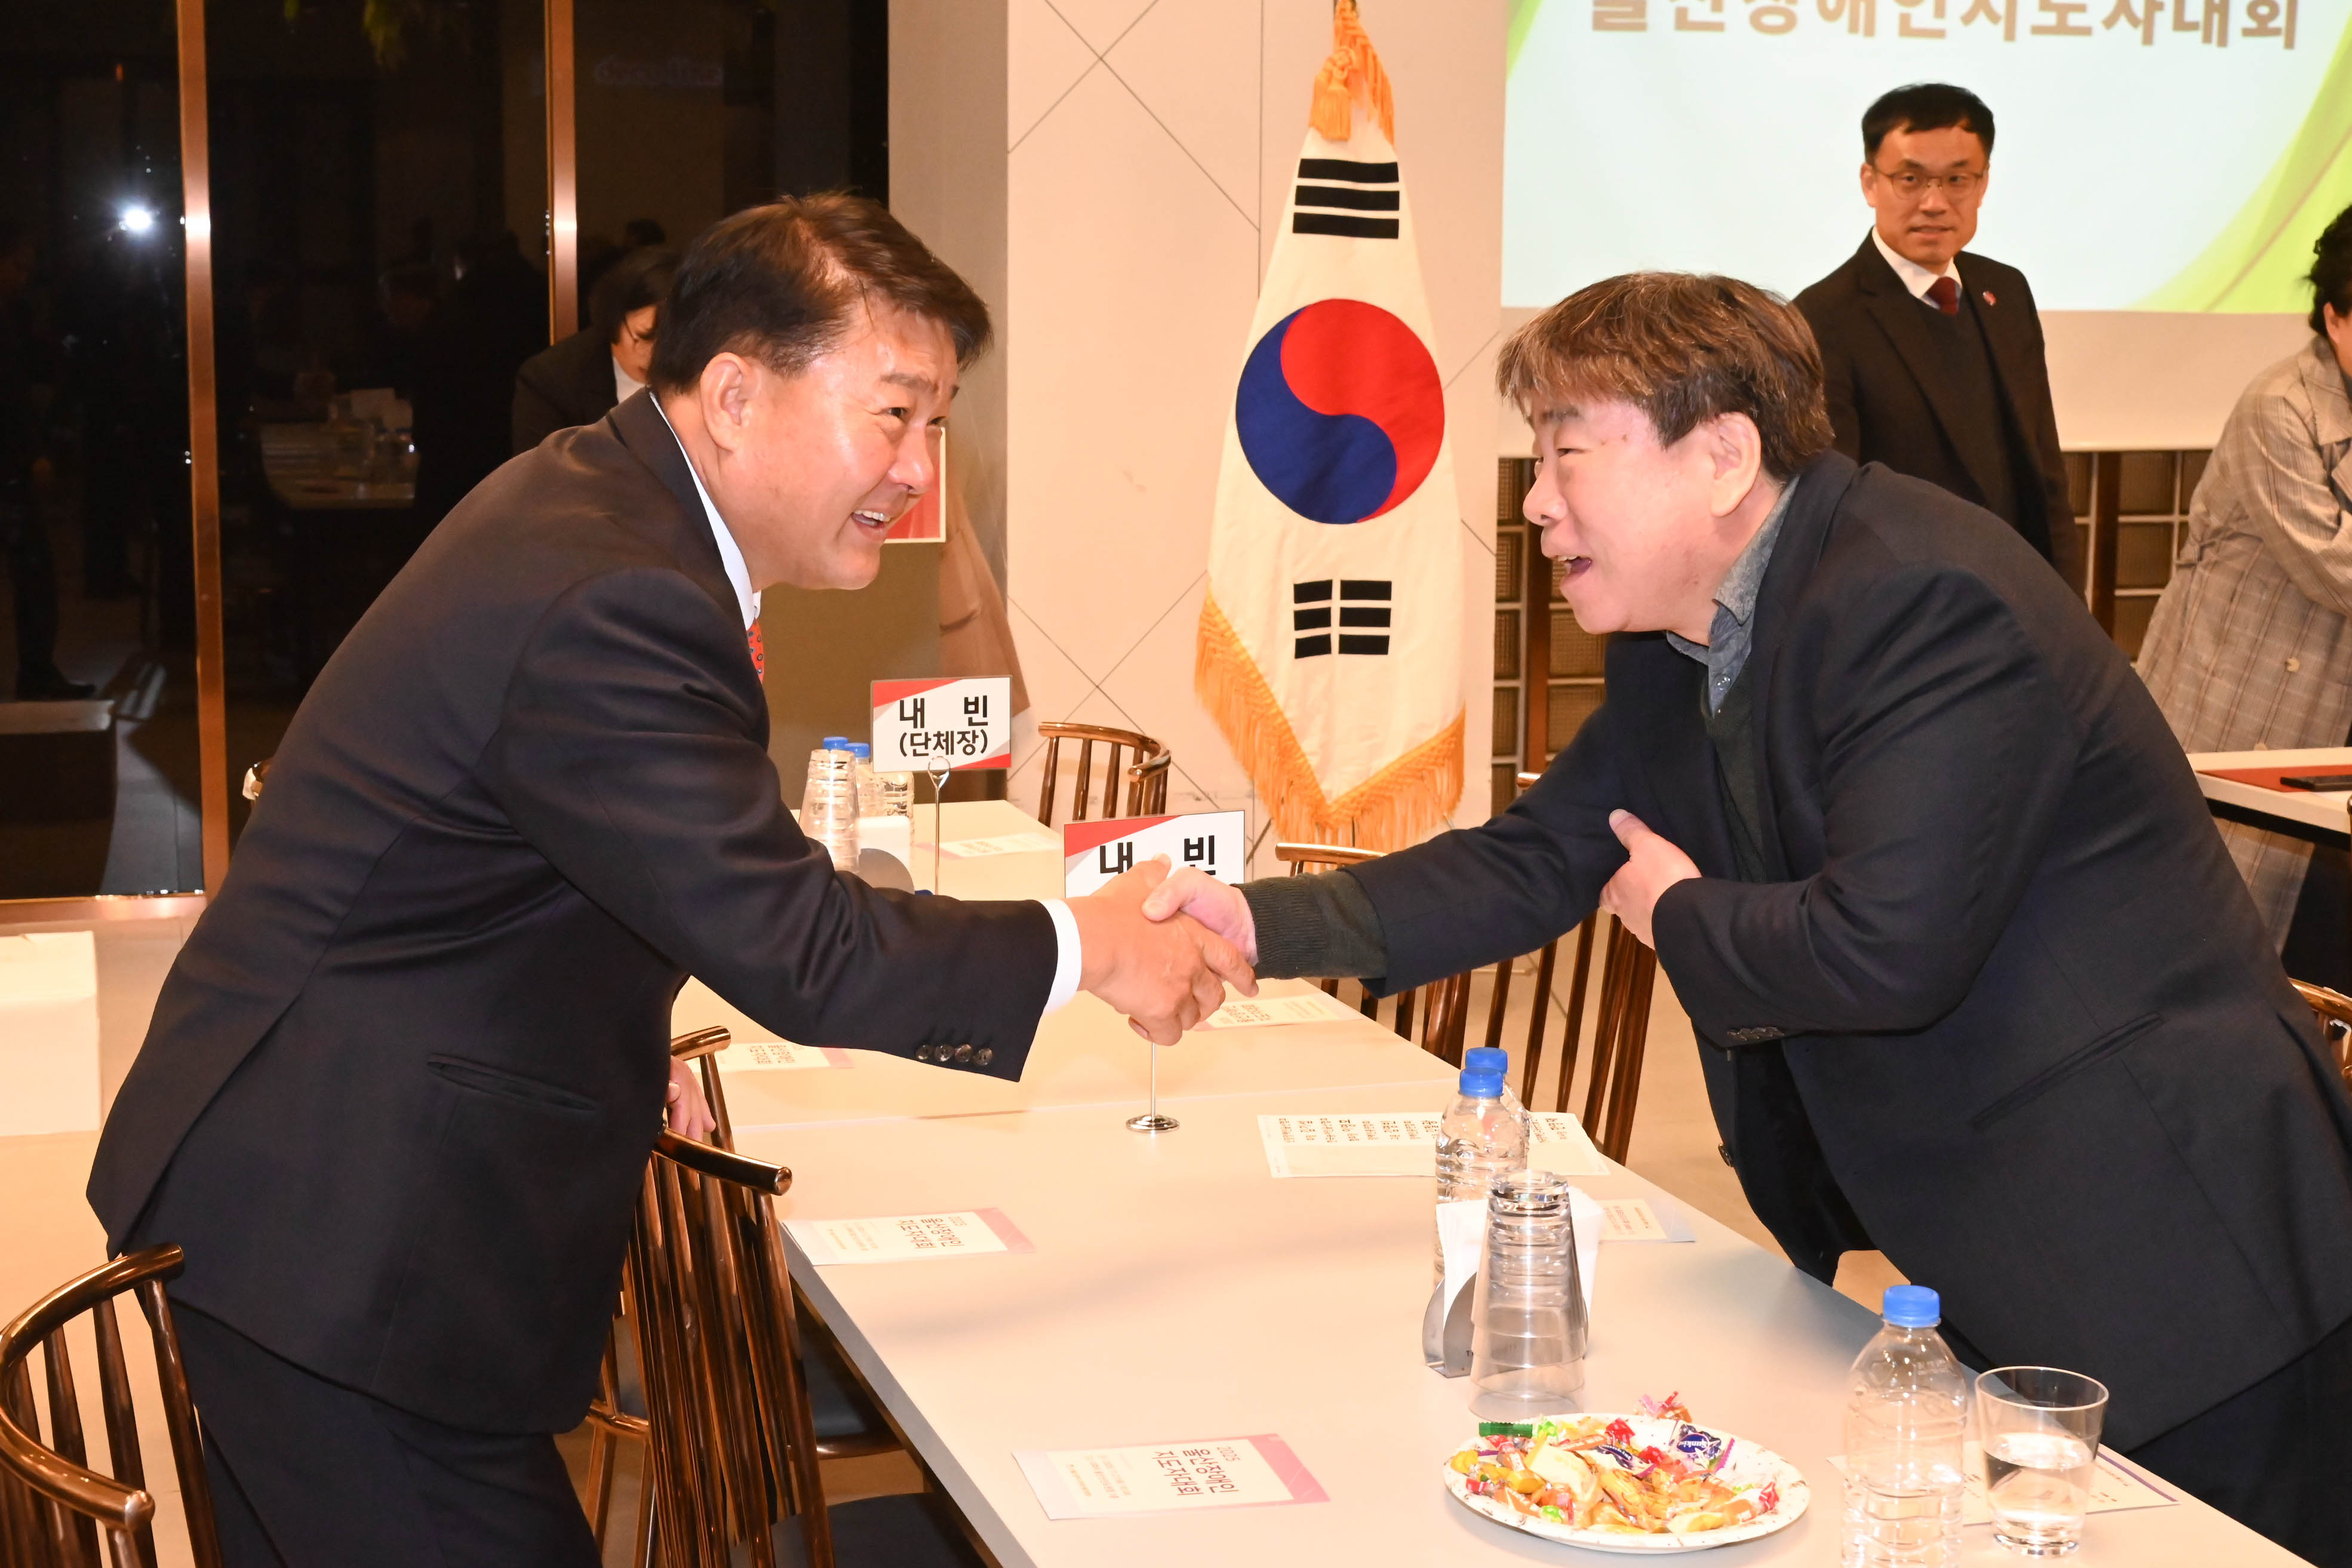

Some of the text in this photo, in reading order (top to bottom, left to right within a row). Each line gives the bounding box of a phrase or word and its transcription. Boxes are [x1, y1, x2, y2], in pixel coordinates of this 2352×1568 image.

[899, 695, 988, 729] 내 빈
[899, 729, 988, 757] (단체장)
[1099, 835, 1216, 876] 내 빈
[894, 1219, 937, 1249] 지도자대회
[920, 1218, 965, 1247] 울산장애인
[1216, 1446, 1242, 1462] 2025
[1151, 1450, 1204, 1496] 지도자대회
[1182, 1449, 1240, 1493] 울산장애인
